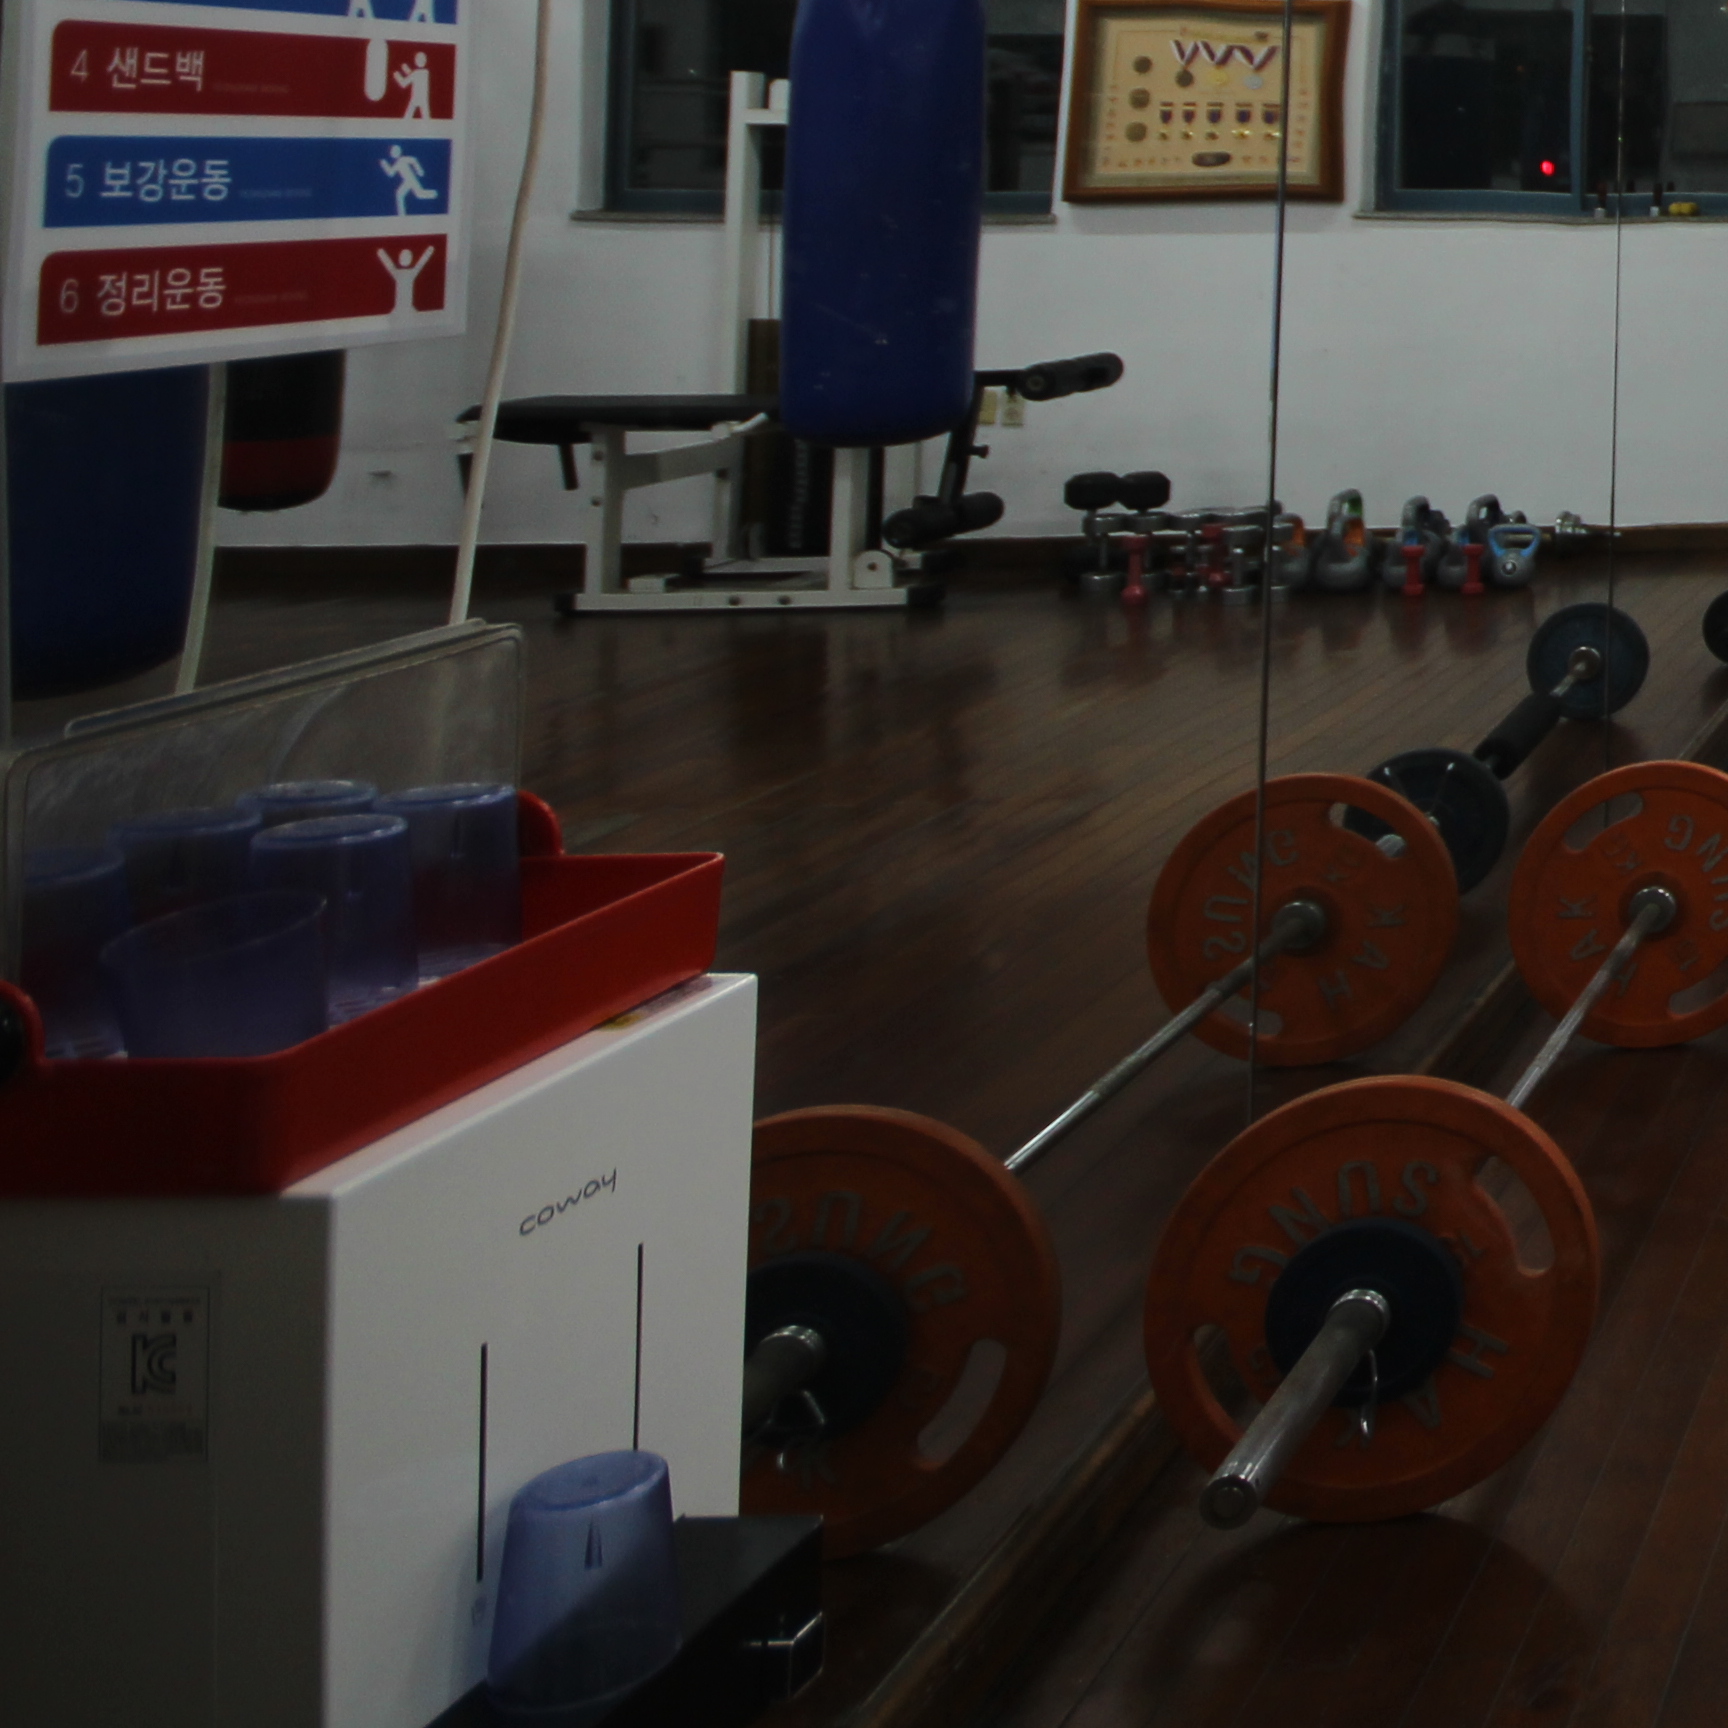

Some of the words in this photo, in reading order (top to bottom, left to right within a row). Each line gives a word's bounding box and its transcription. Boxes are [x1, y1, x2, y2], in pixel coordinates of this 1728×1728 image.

[69, 48, 89, 84] 4
[107, 46, 206, 93] 샌드백
[64, 162, 86, 199] 5
[99, 158, 233, 203] 보강운동
[59, 277, 80, 315] 6
[96, 266, 227, 317] 정리운동
[519, 1166, 618, 1237] coway
